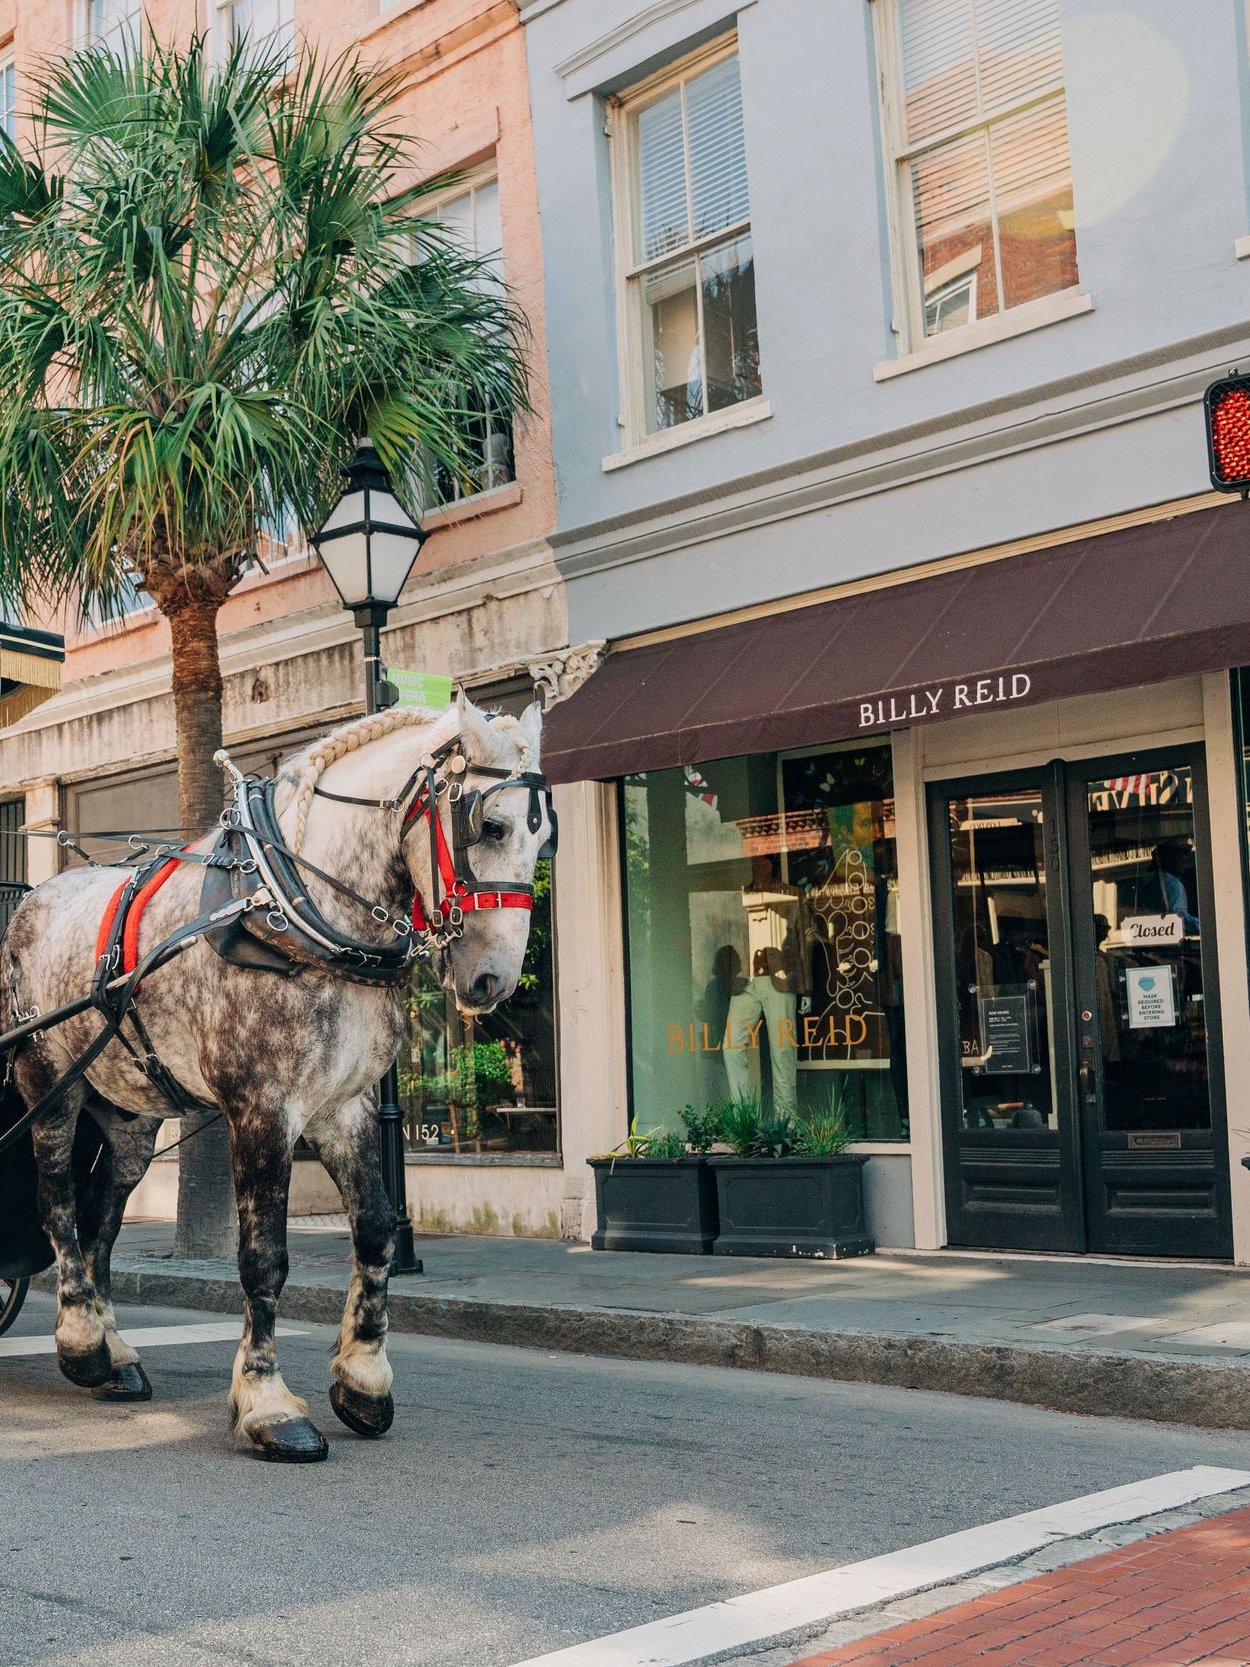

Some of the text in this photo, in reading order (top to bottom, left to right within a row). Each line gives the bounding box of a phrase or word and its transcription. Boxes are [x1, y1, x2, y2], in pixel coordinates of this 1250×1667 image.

[392, 672, 424, 688] MUSIC
[399, 689, 427, 703] PERA
[858, 673, 1031, 727] BILLY REID
[1130, 922, 1175, 938] Closed
[668, 1014, 867, 1053] BILLY REID
[415, 1124, 439, 1140] 152
